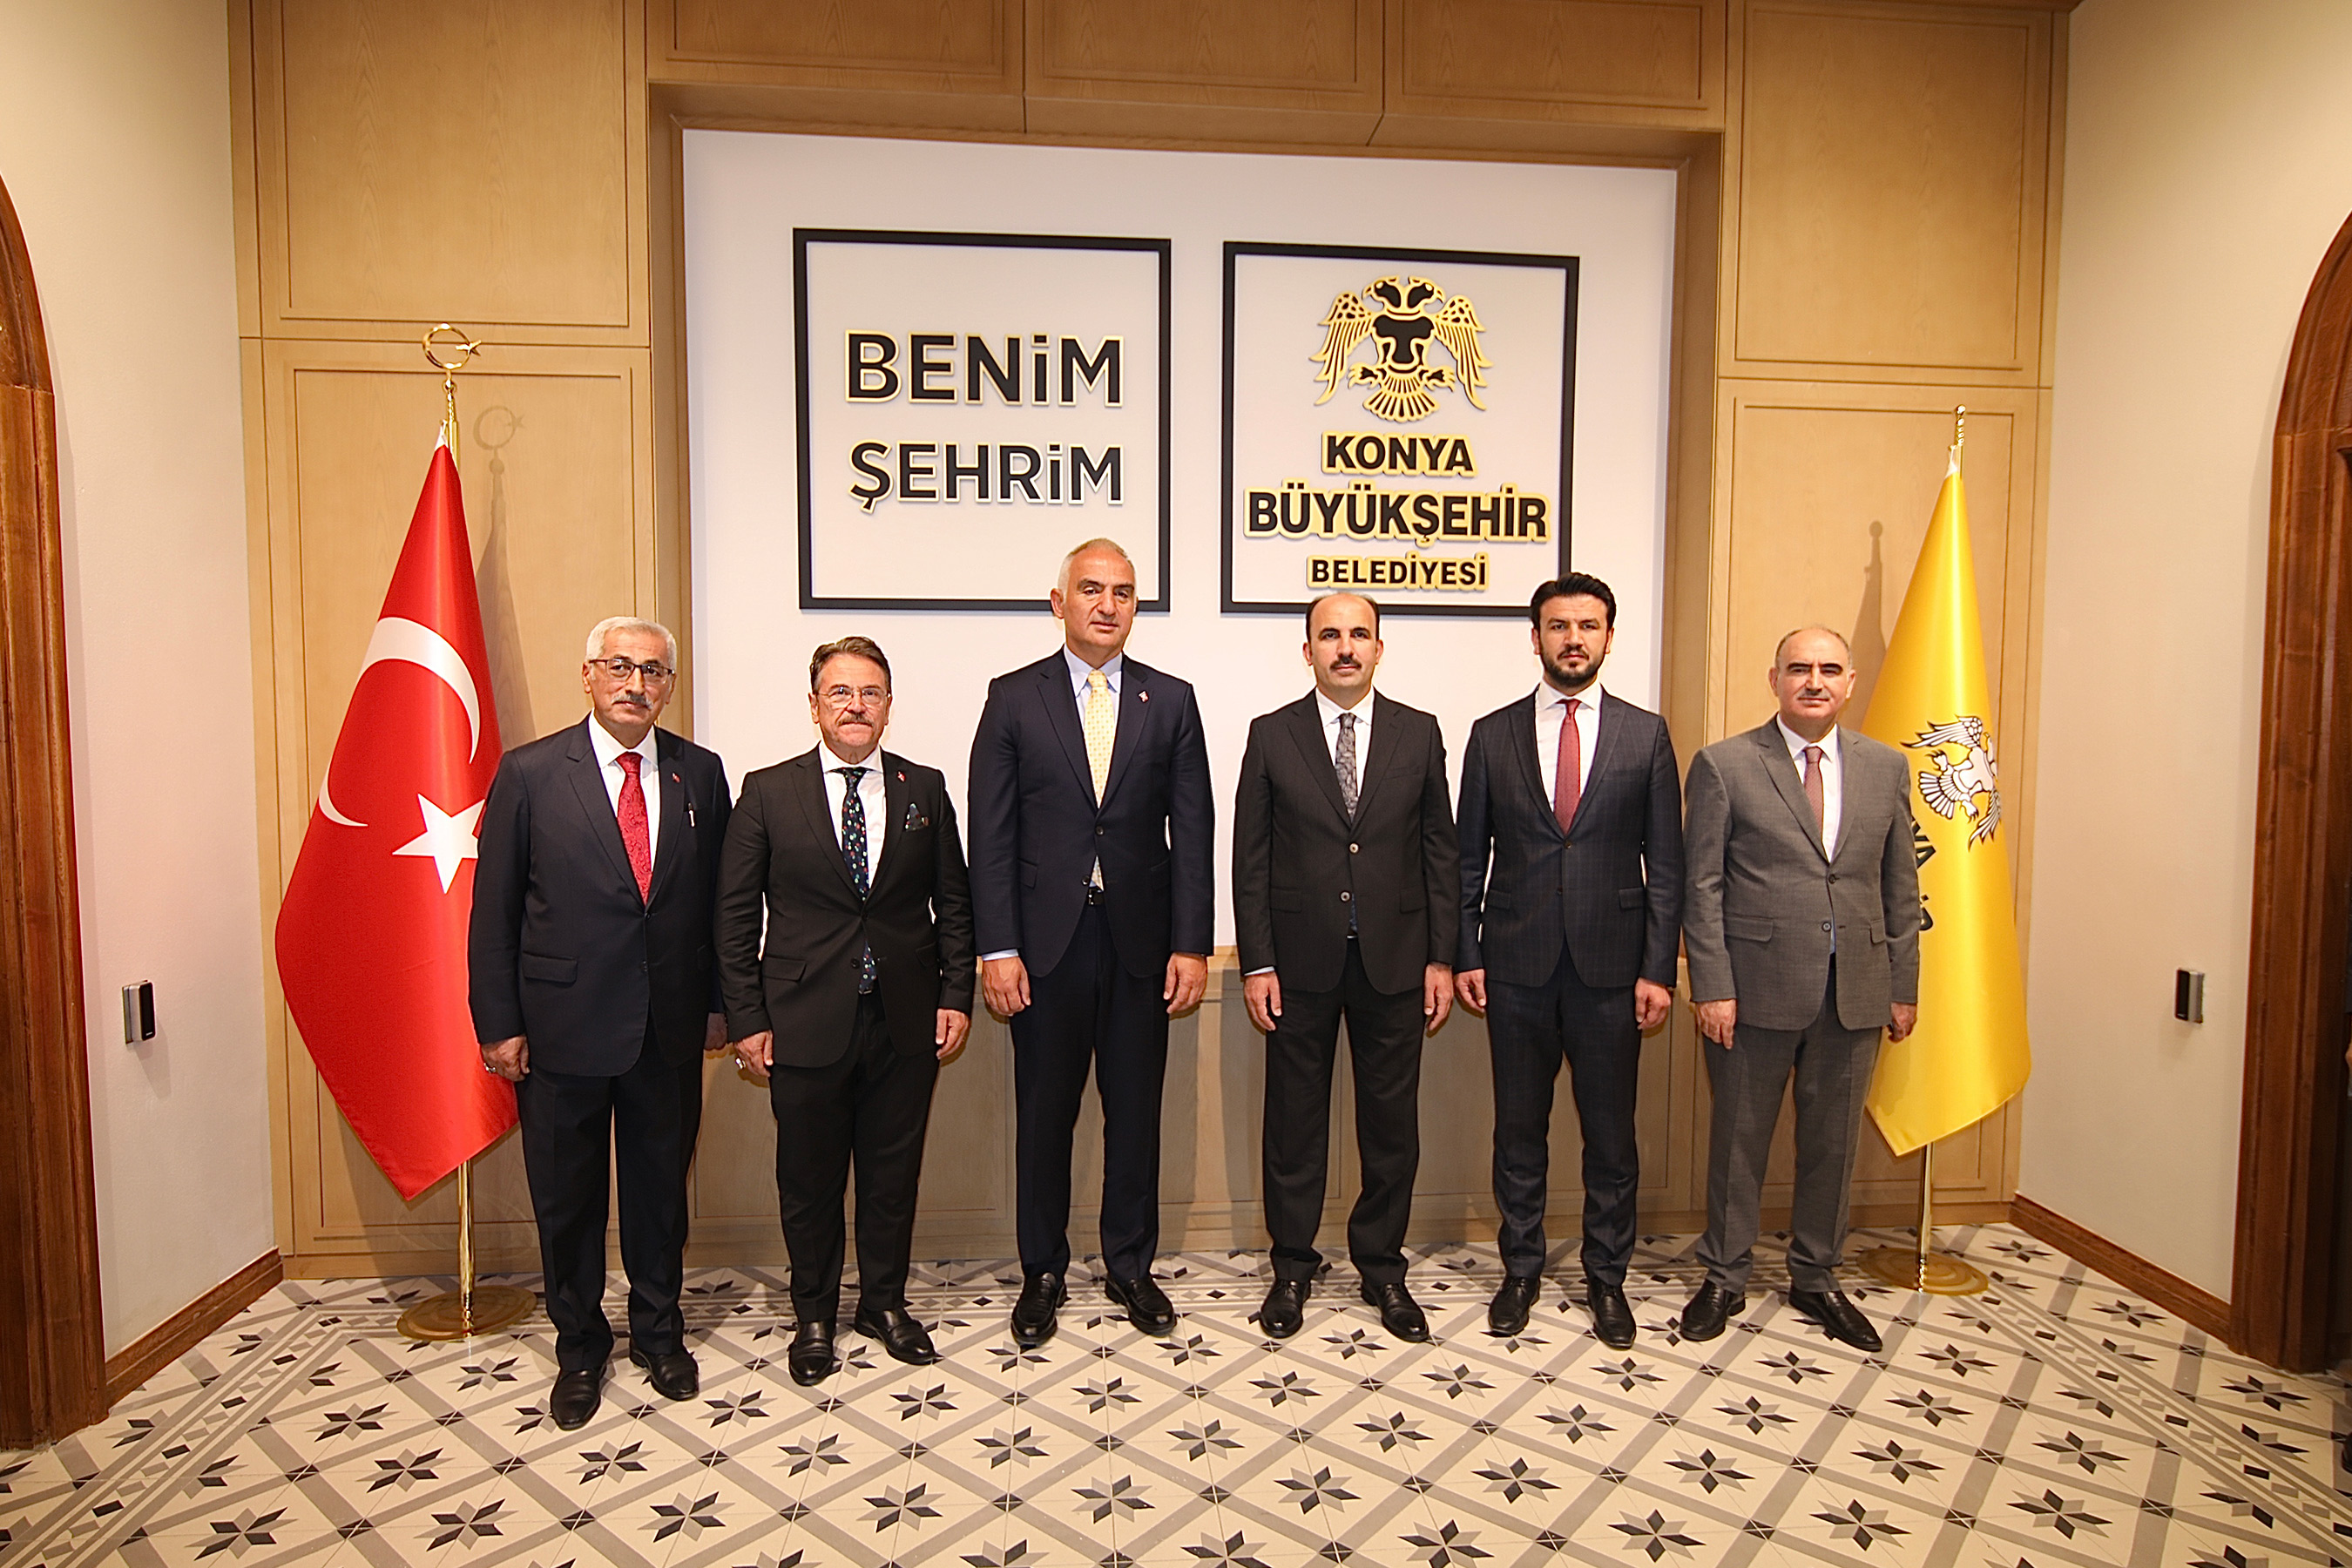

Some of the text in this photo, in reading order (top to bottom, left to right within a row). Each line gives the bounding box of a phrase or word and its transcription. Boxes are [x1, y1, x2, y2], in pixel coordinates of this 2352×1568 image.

[1325, 434, 1475, 473] KONYA
[1247, 481, 1548, 544] BÜYÜKŞEHİR
[1310, 553, 1487, 587] BELEDİYESİ
